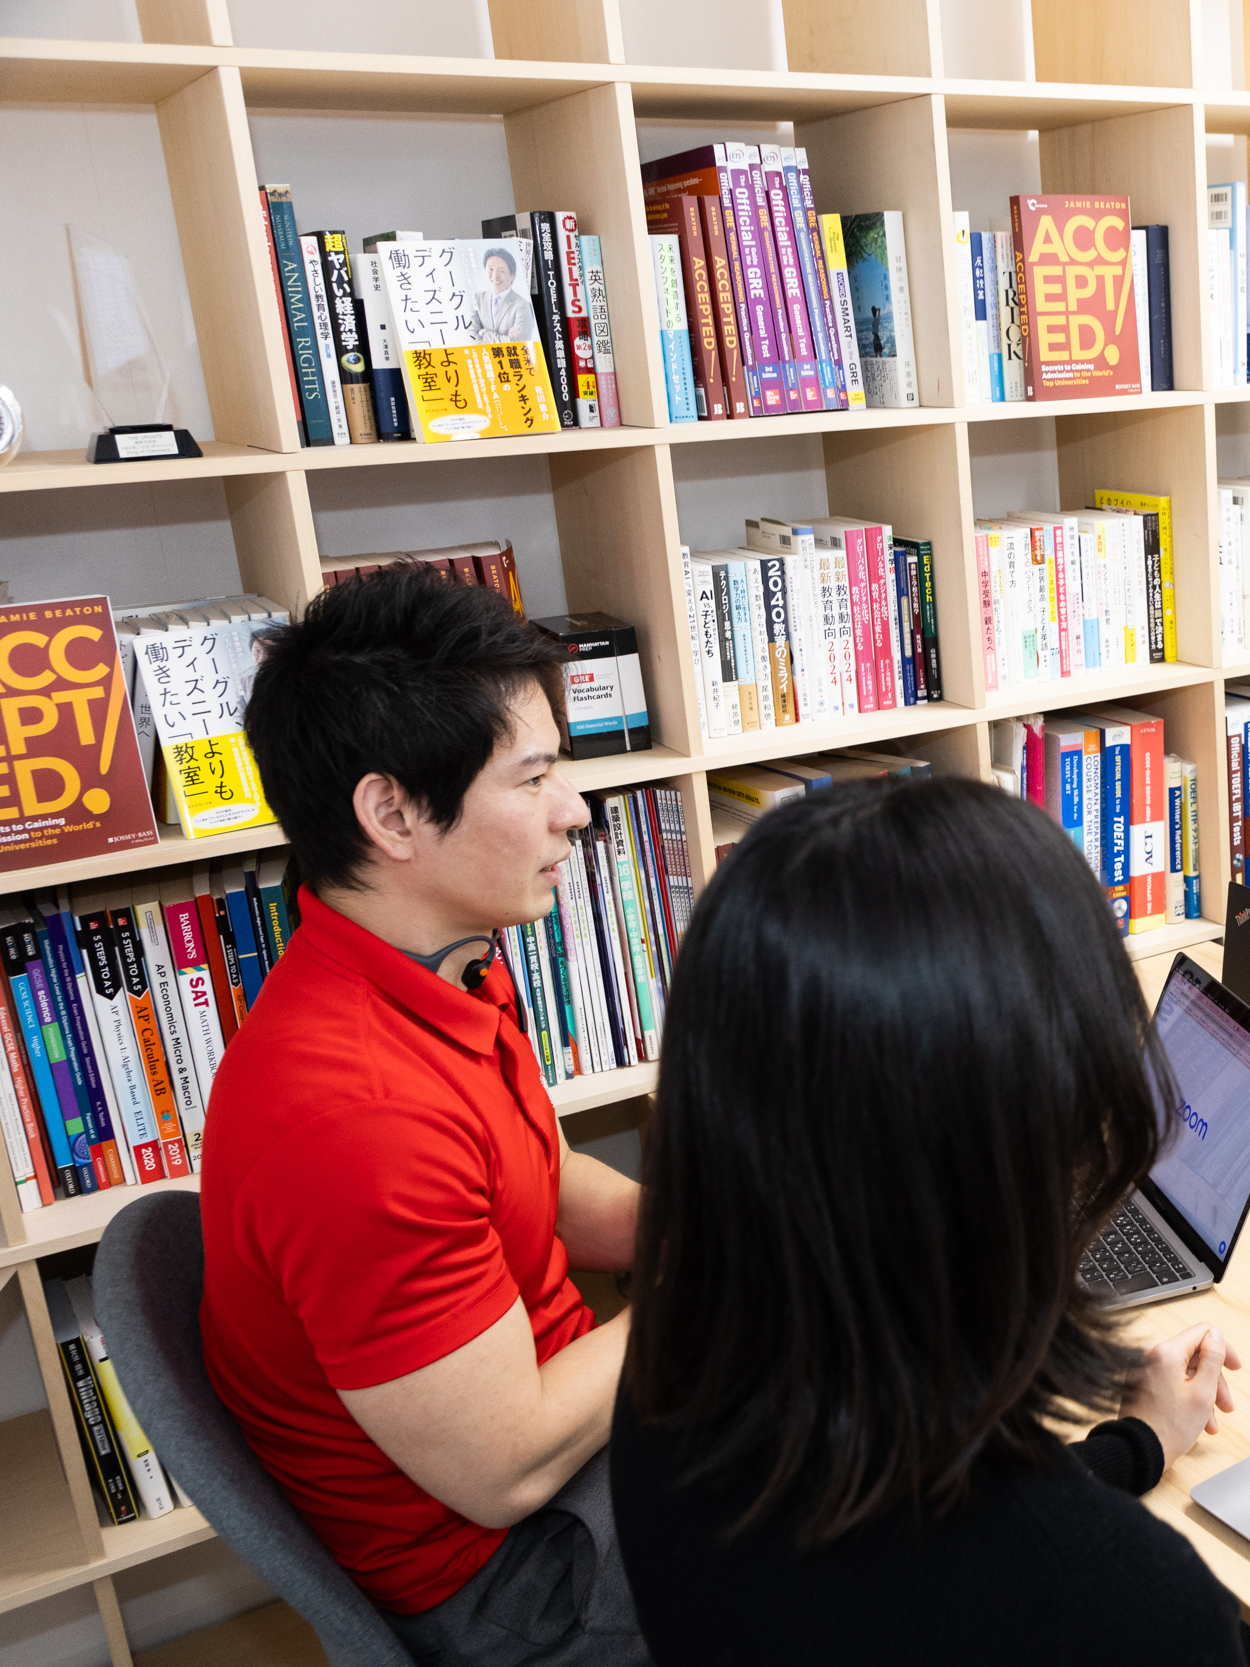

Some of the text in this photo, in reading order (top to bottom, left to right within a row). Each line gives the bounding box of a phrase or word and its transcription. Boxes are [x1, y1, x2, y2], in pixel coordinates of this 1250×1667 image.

[566, 219, 575, 229] 新
[689, 207, 697, 237] BEATON
[735, 188, 756, 246] Official
[1064, 200, 1127, 210] JAMIE BEATON
[1028, 215, 1127, 263] ACC
[370, 260, 381, 292] 社会学史
[565, 234, 583, 314] IELTS
[574, 234, 584, 285] セルフスタディ
[719, 173, 753, 366] Official GRE VERBAL REASONING Practice Questions
[324, 234, 359, 350] 超ヤバい経済学
[658, 243, 674, 329] スタンフォードの
[837, 271, 847, 299] WORD
[388, 249, 445, 405] 働きたい「教室」
[588, 270, 611, 355] 英熟語図鑑
[693, 256, 716, 383] ACCEPTED!
[840, 299, 853, 339] SMART
[1003, 270, 1023, 361] TRICK
[1015, 251, 1029, 367] ACCEPTED!
[282, 259, 320, 400] ANIMAL RIGHTS
[577, 319, 589, 342] 攻略
[520, 345, 536, 377] 全米で
[666, 331, 682, 404] マインドセット
[849, 362, 859, 386] GRE
[1041, 364, 1064, 372] Secrets
[1071, 363, 1095, 371] Gaining
[1092, 369, 1114, 377] World's
[505, 346, 535, 429] 就職ランキング
[1055, 378, 1089, 386] Universities
[534, 385, 550, 421] 松田悠介
[886, 535, 896, 575] 未来の学校
[1006, 535, 1017, 589] 一流の育て方
[1022, 532, 1034, 614] 子育てのパラドックス
[1068, 526, 1077, 582] 地頭力を鍛える
[699, 589, 714, 601] AI
[855, 538, 869, 624] グローバル化、デジタル化で
[923, 555, 933, 603] EdTech
[1055, 528, 1067, 629] 世界に通用する子どもの育て方
[45, 605, 103, 619] BEATON
[719, 570, 732, 640] テクノロジー思考
[732, 579, 743, 624] 数学力の鍛え方
[740, 578, 749, 623] AI時代に生きる
[851, 586, 864, 651] 教育、社会は変わる
[981, 569, 995, 651] 中学受験の親たちへ
[578, 640, 610, 648] MANHATTAN
[701, 610, 714, 658] 子どもたち
[767, 560, 788, 693] 2040教育のミライ
[0, 624, 111, 692] CC
[200, 632, 243, 728] グーグル、
[571, 684, 614, 695] Vocabulary
[573, 692, 613, 703] Flashcards
[711, 680, 721, 710] 新井紀子
[144, 641, 209, 798] 働きたい「教室」
[172, 636, 234, 801] ディズニーよりも
[1114, 755, 1122, 781] OFFICIAL
[1174, 789, 1181, 797] A
[1230, 736, 1242, 846] Official TOEFL iBT Tests
[12, 816, 66, 832] to Gaining
[30, 820, 101, 839] to the World's
[610, 805, 626, 856] 建築設計資料
[1174, 797, 1182, 830] Writer's
[114, 830, 154, 843] JOSSEY-BASS
[1113, 815, 1124, 854] TOEFL
[1144, 830, 1154, 866] ACT
[617, 862, 630, 877] 16
[1114, 854, 1124, 883] Test
[620, 880, 634, 901] 学校
[94, 942, 108, 966] STEPS
[179, 912, 198, 960] BARRON'S
[626, 906, 646, 983] 小学校・中学校・高等学校
[99, 965, 111, 980] TO
[103, 980, 112, 988] A
[155, 963, 166, 978] AP
[32, 968, 52, 1023] GCSE science
[105, 987, 114, 995] 5
[159, 980, 178, 1036] Economics
[189, 976, 210, 1008] SAT
[199, 1008, 210, 1037] MATH
[135, 1005, 167, 1097] AP Calculus AB
[171, 1036, 184, 1065] Micro
[180, 1075, 193, 1107] Macro
[1175, 1098, 1209, 1141] zoom
[107, 1148, 119, 1179] CAMBRIDGE
[141, 1146, 156, 1171] 2020
[168, 1143, 183, 1166] 2019
[64, 1169, 76, 1195] OXFORD
[82, 1166, 92, 1189] OXFORD
[77, 1376, 102, 1426] Vintage
